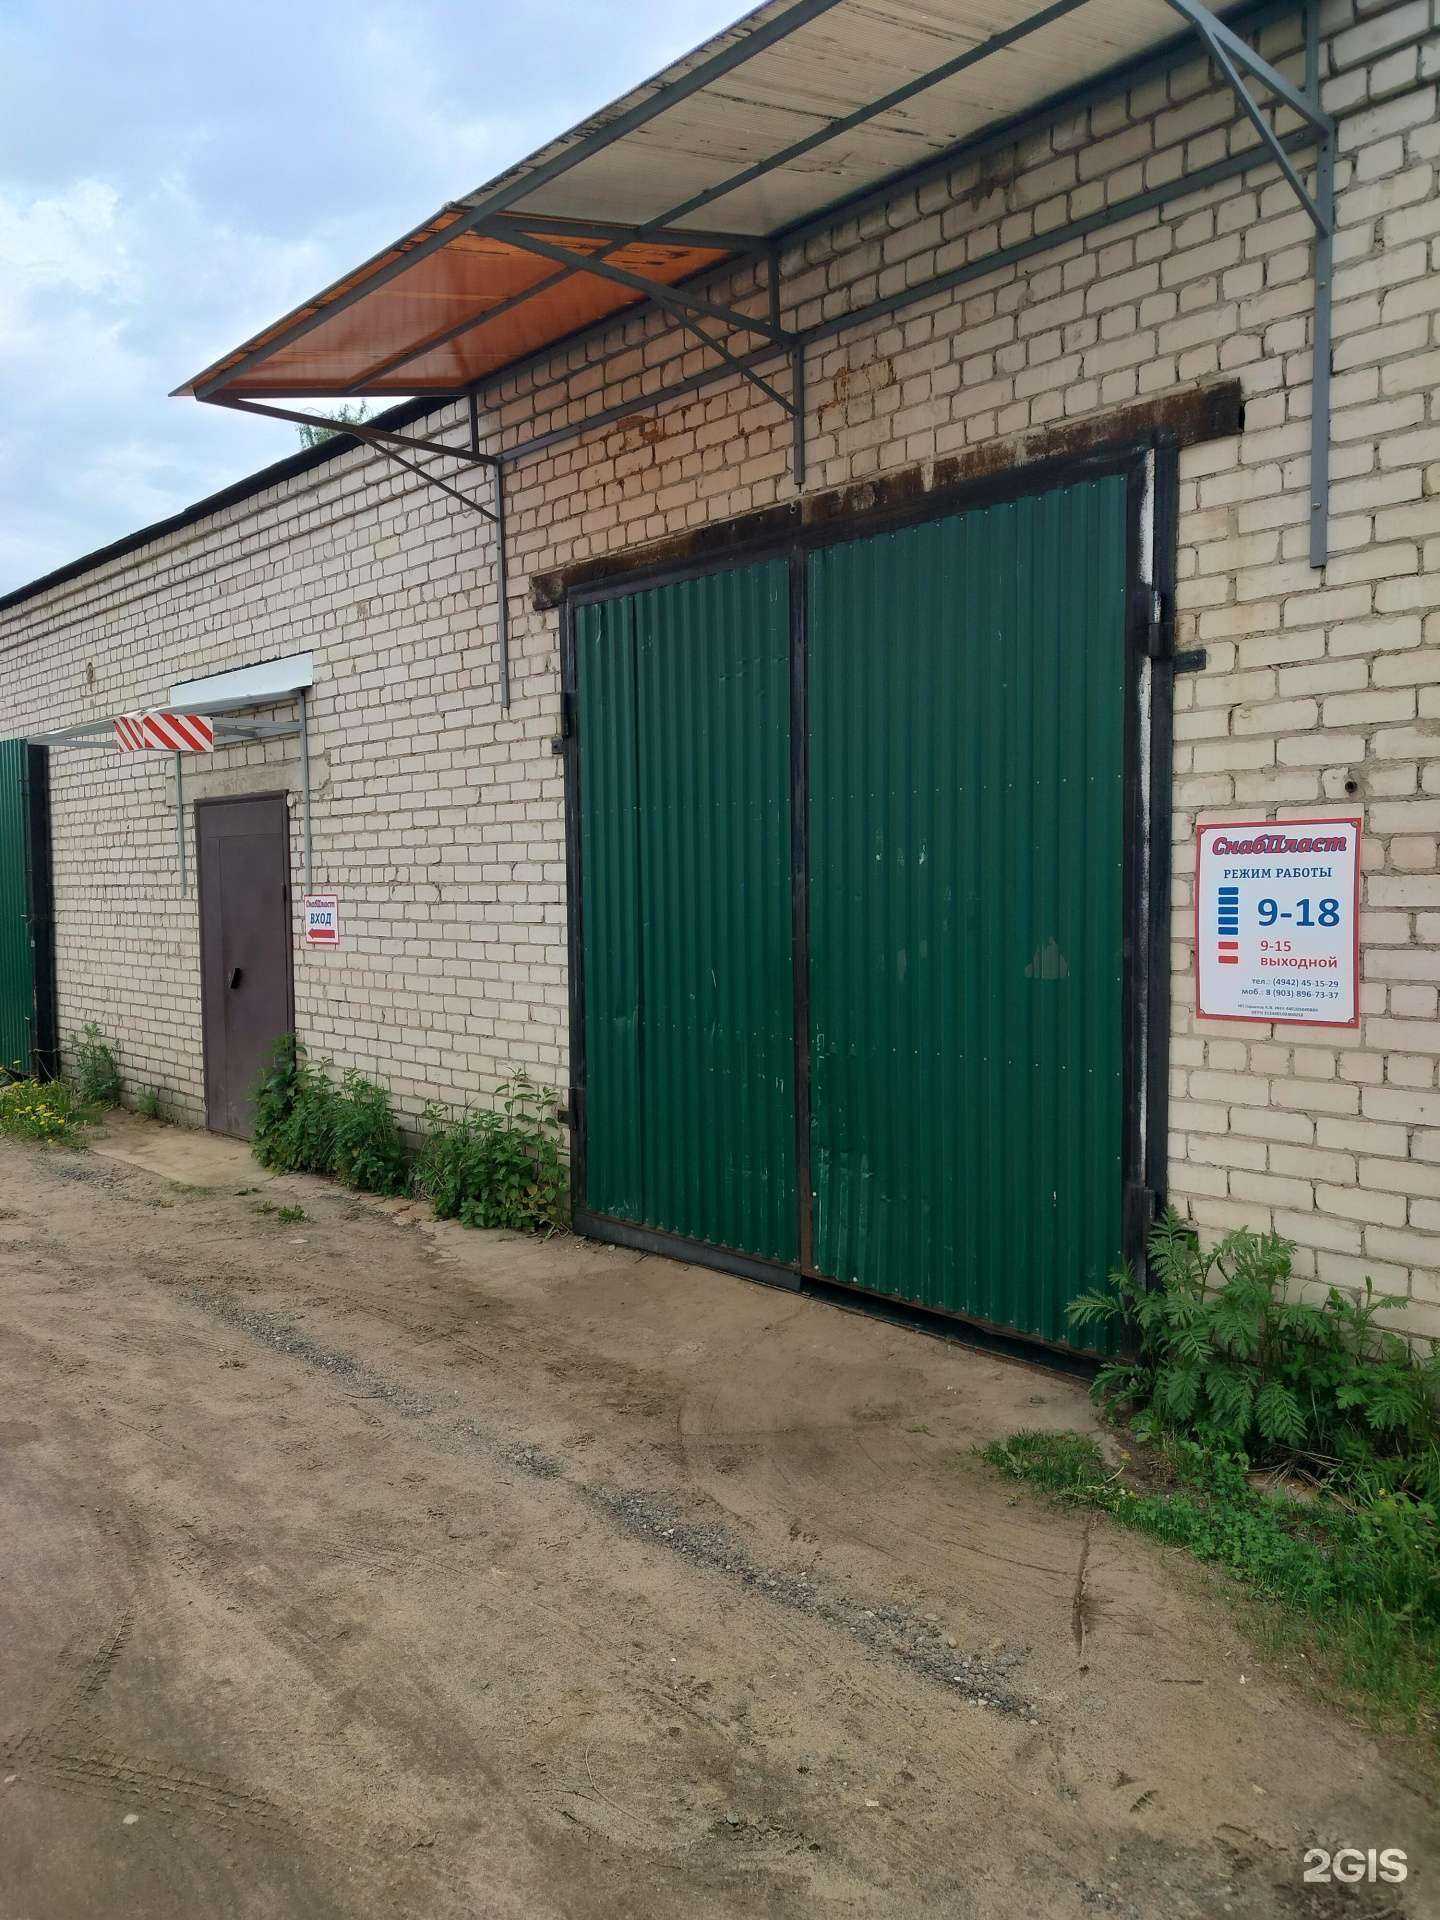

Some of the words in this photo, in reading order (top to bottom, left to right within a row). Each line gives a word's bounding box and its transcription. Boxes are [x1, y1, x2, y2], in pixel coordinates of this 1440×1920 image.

[1212, 835, 1347, 855] СнабПласт
[1223, 868, 1271, 879] РЕЖИМ
[1276, 867, 1332, 878] РАБОТЫ
[1257, 899, 1340, 927] 9-18
[310, 913, 331, 926] ВХОД
[1260, 941, 1291, 952] 9-15
[1273, 978, 1298, 987] (4942)
[1273, 989, 1294, 998] (903)
